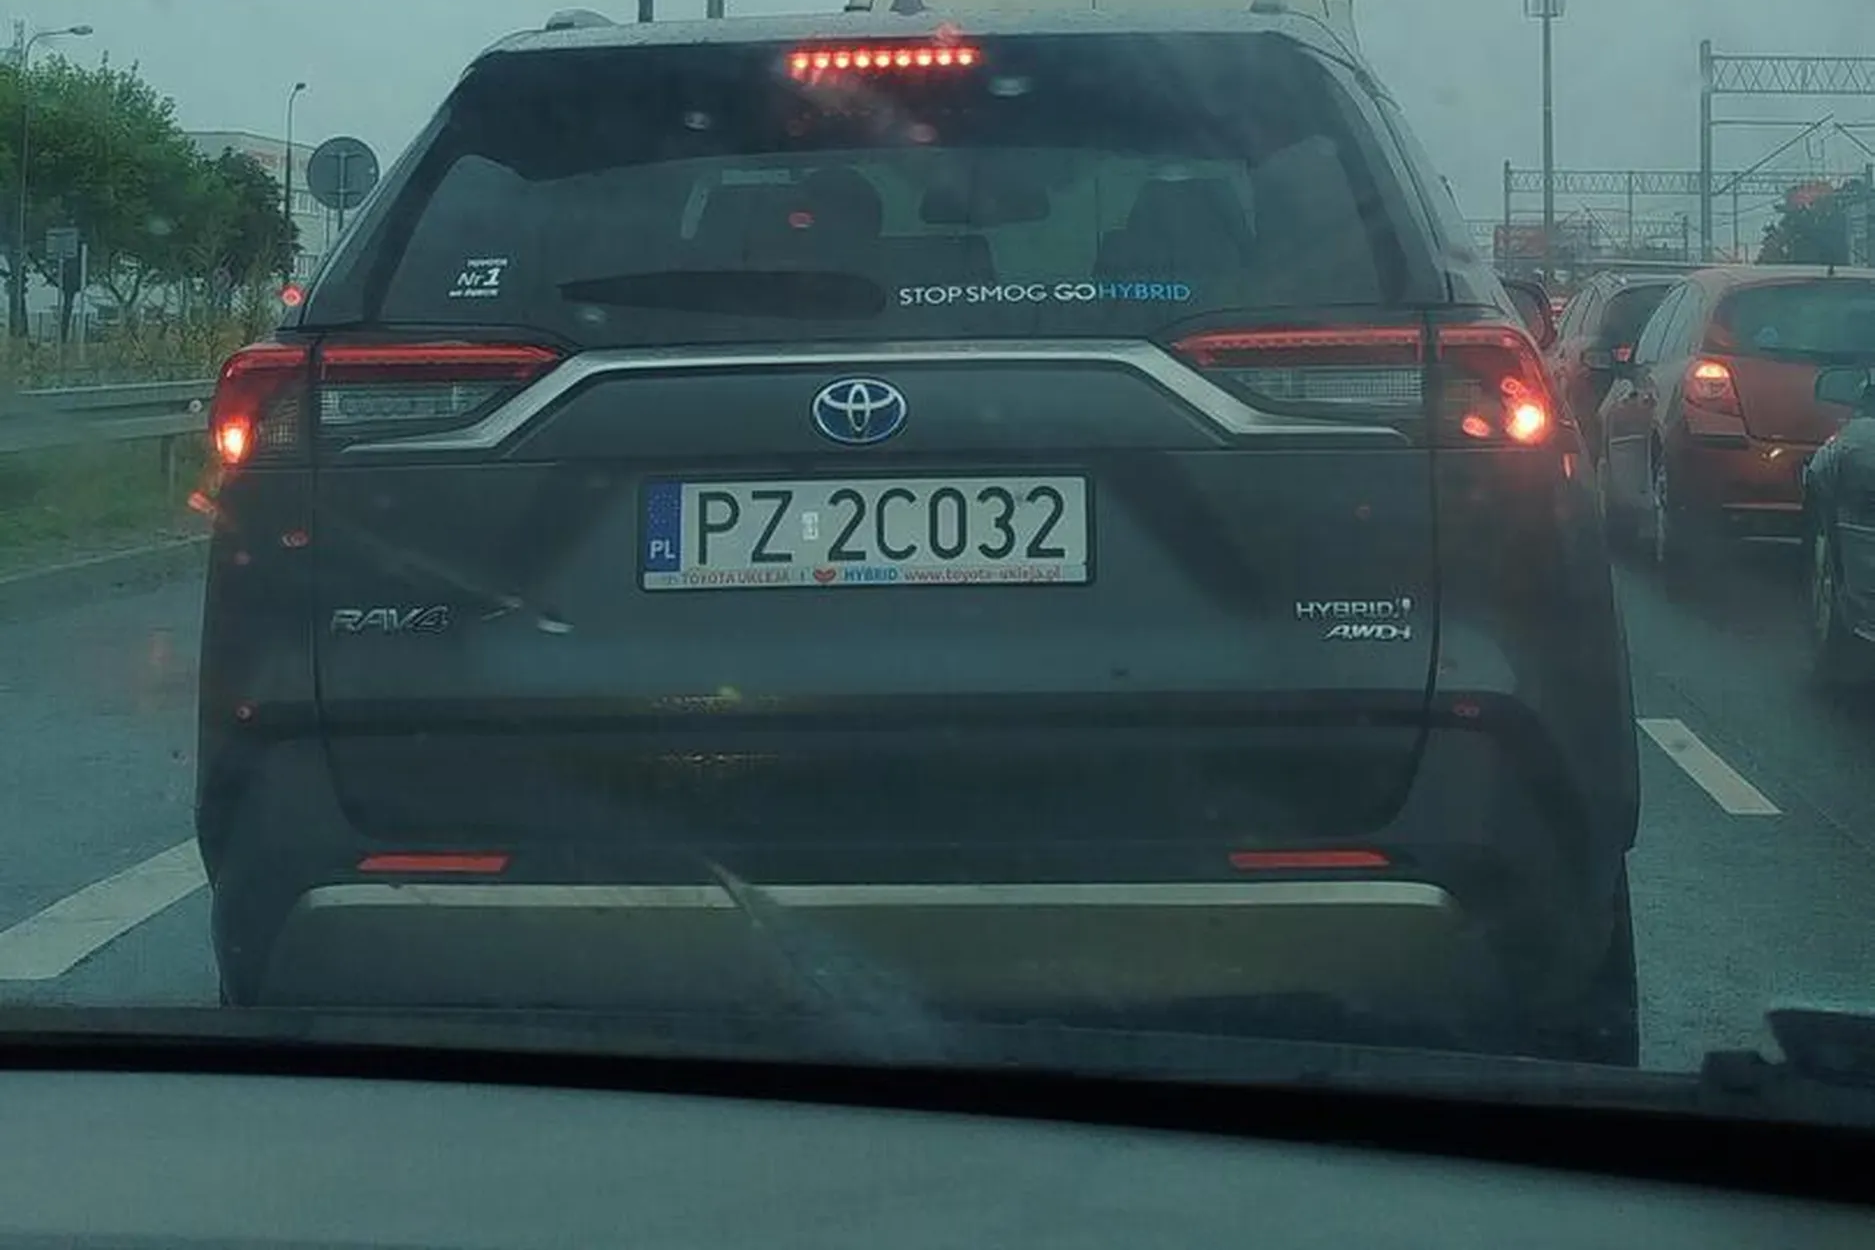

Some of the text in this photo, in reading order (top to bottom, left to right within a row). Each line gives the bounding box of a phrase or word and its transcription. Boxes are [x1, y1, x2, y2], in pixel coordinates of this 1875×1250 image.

[899, 286, 963, 306] STOP
[965, 284, 1048, 302] SMOG
[698, 485, 1067, 566] PZ 2C032
[650, 539, 676, 559] PL
[843, 565, 898, 582] HYBRID
[330, 605, 449, 632] RAV4
[1295, 600, 1394, 619] HYBRID
